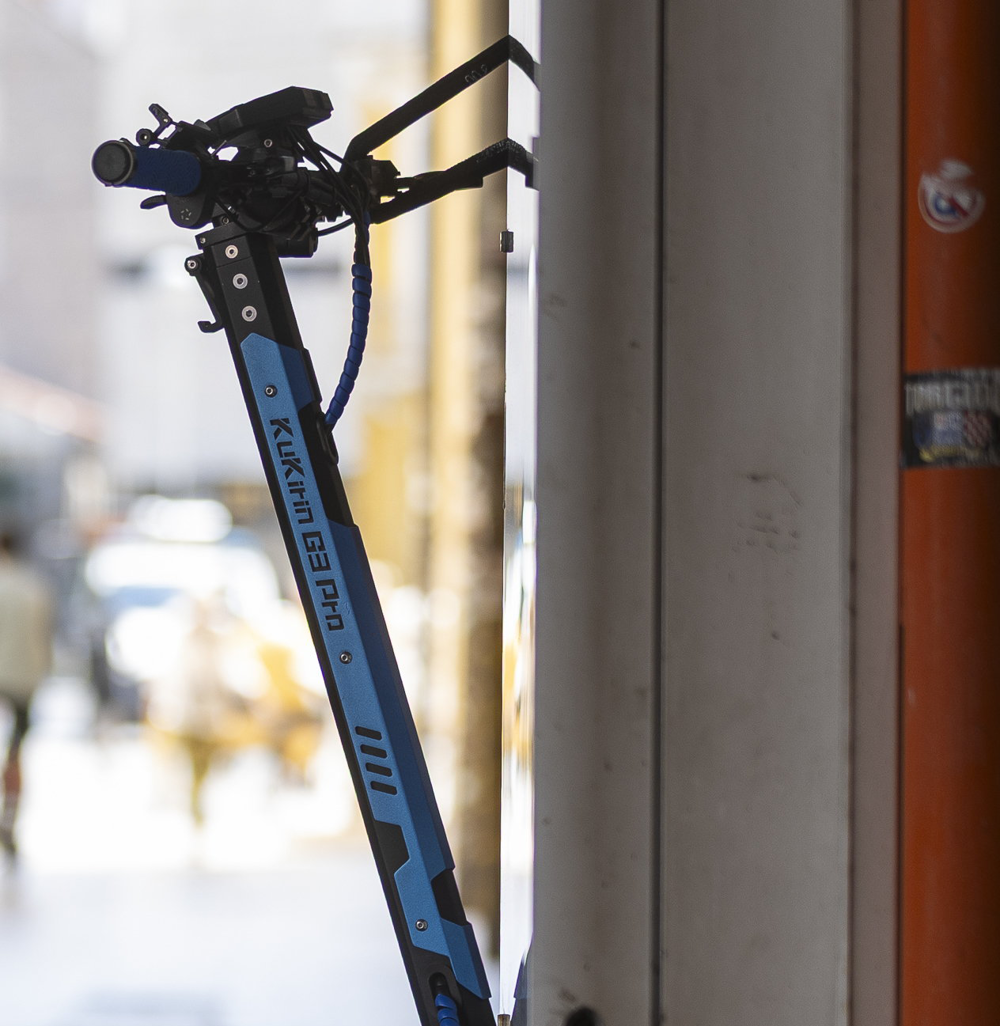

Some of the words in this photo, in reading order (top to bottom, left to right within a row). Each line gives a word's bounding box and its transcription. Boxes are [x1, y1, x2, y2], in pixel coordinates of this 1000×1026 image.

[270, 418, 313, 524] KuKirin
[302, 531, 331, 572] G3
[315, 579, 345, 631] Pro
